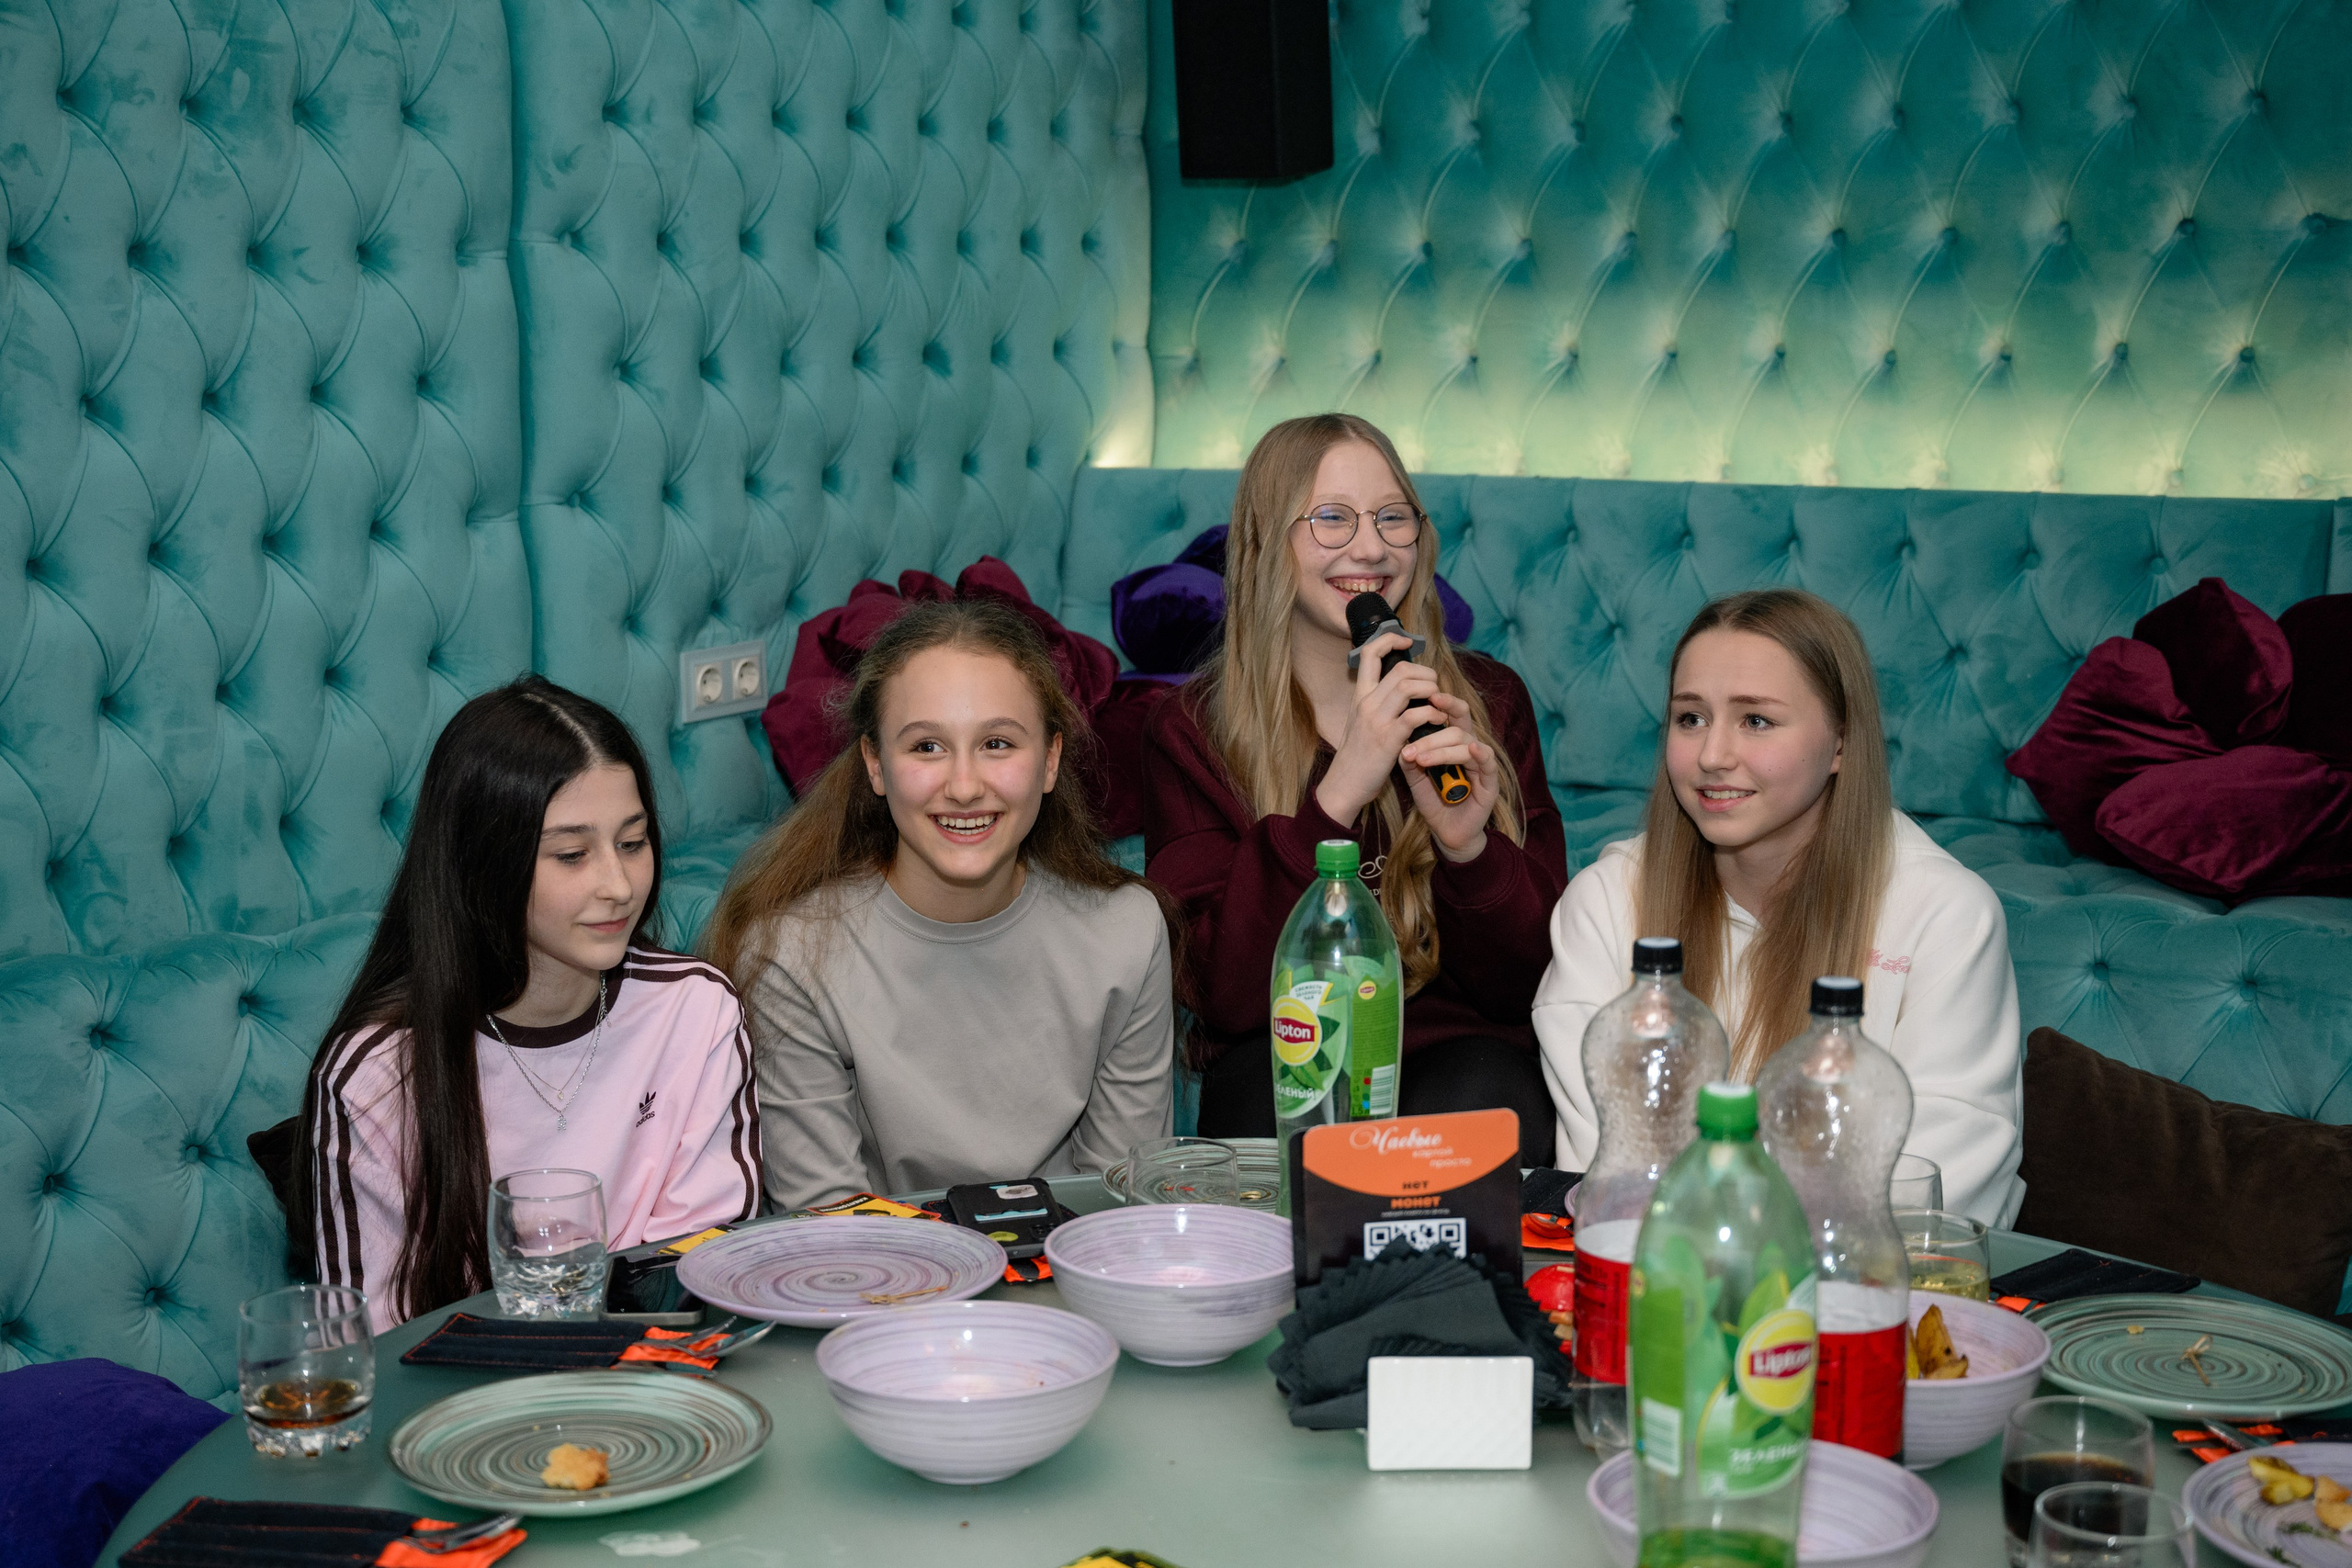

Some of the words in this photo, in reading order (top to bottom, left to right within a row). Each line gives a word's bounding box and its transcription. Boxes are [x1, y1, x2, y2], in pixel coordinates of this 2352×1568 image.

[1274, 1019, 1312, 1040] Lipton
[636, 1111, 655, 1128] adidas
[1349, 1124, 1442, 1156] Чаевые
